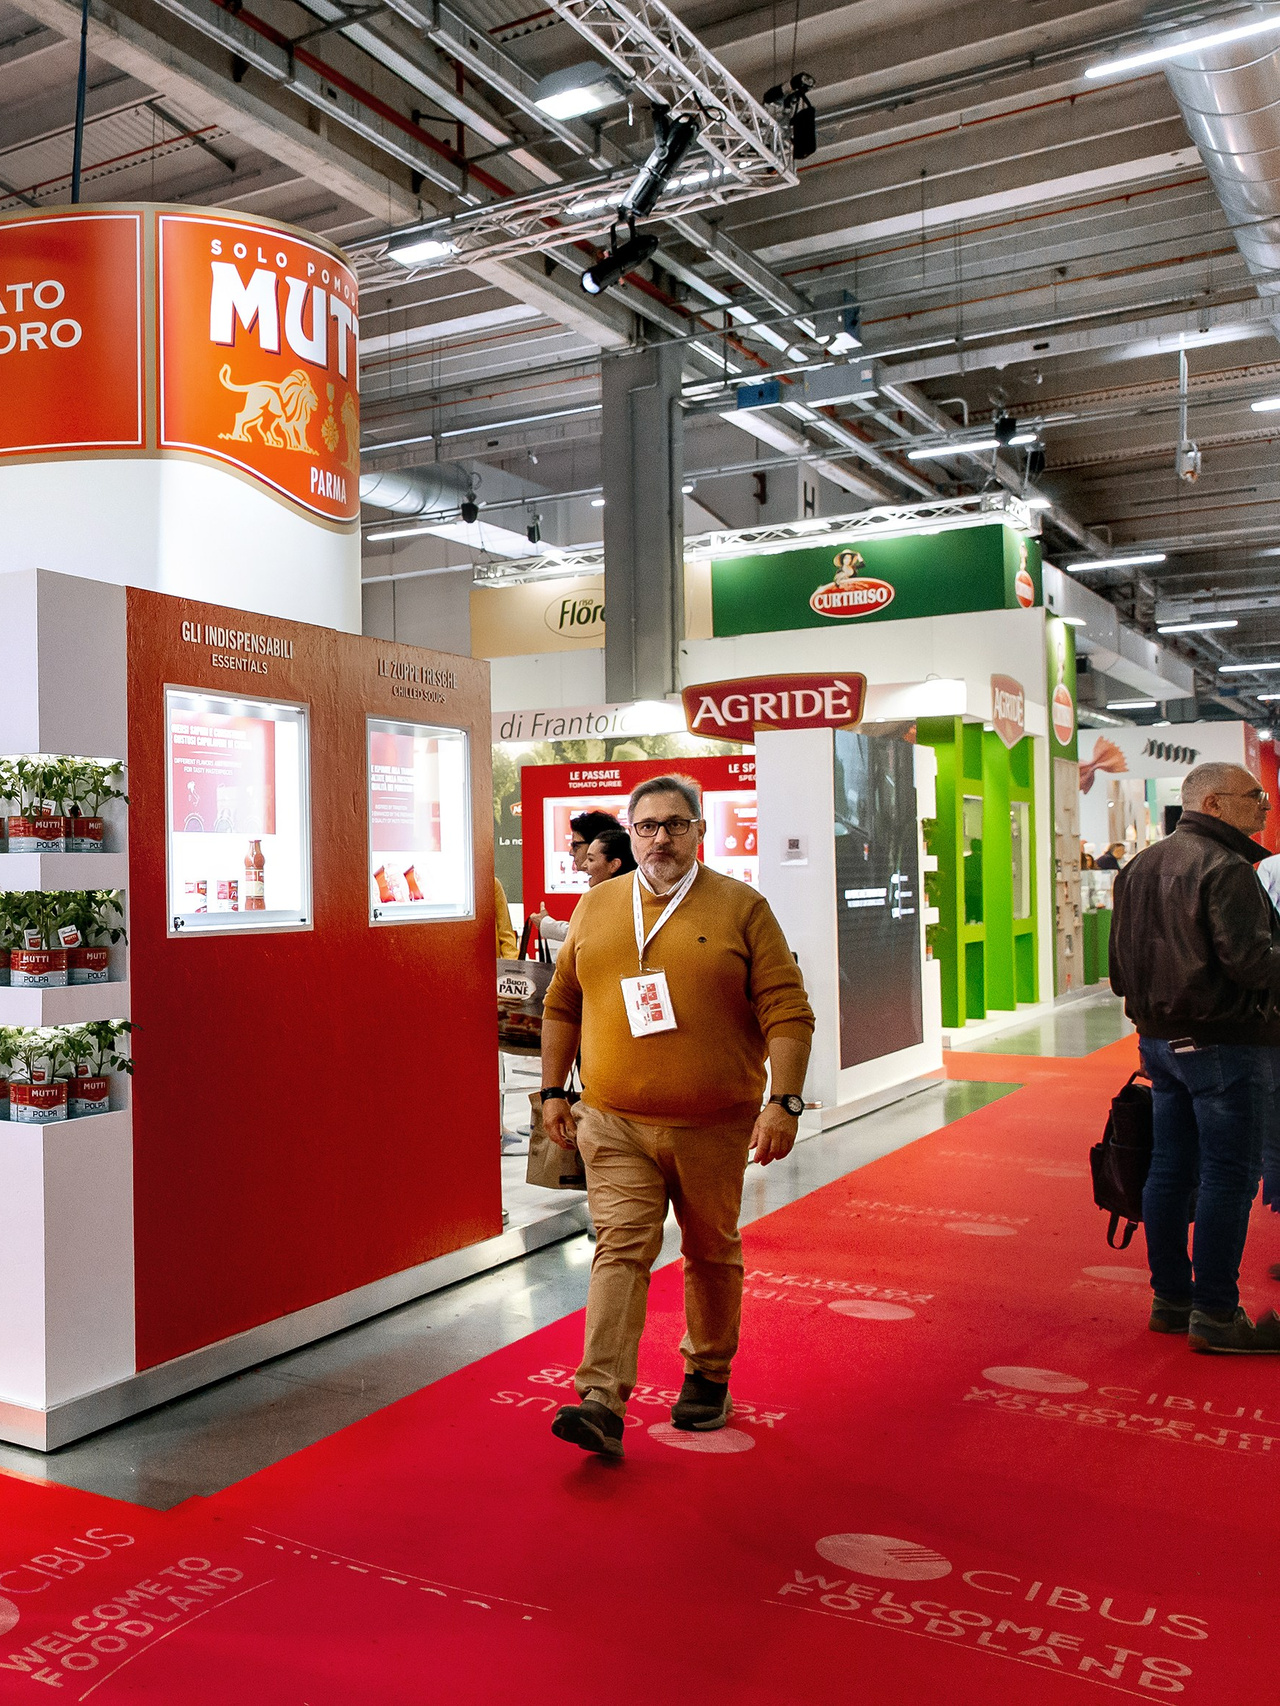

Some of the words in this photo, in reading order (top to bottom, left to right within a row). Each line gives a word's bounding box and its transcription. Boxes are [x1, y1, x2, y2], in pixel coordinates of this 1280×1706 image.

[210, 239, 288, 268] SOLO
[307, 262, 359, 314] POMOD
[309, 465, 348, 505] PARMA
[813, 585, 888, 610] CURTIRISO
[181, 620, 201, 644] GLI
[204, 624, 294, 660] INDISPENSABILI
[211, 653, 269, 675] ESSENTIALS
[377, 658, 389, 677] LE
[390, 660, 420, 683] ZUPPE
[392, 684, 422, 700] CHILLED
[691, 679, 853, 729] AGRIDÈ
[499, 712, 523, 740] di
[569, 771, 580, 781] LE
[581, 769, 621, 780] PASSATE
[728, 763, 740, 774] LE
[568, 781, 598, 789] TOMATO
[35, 820, 61, 830] MUTTI
[36, 841, 60, 849] POLPA
[499, 836, 511, 846] La
[22, 955, 50, 964] MUTTI
[23, 975, 49, 984] POLPA
[506, 977, 527, 986] Buon
[499, 984, 530, 996] PANE
[83, 1081, 107, 1090] MUTTI
[31, 1088, 58, 1098] MUTTI
[84, 1101, 107, 1110] POLPA
[32, 1109, 58, 1118] POLPA
[162, 1555, 212, 1586] TO
[961, 1568, 1210, 1642] CIBUS
[31, 1565, 245, 1689] FOODLAND
[792, 1568, 1086, 1652] WELCOME
[1104, 1643, 1194, 1678] TO
[776, 1582, 1188, 1694] FOODLAND
